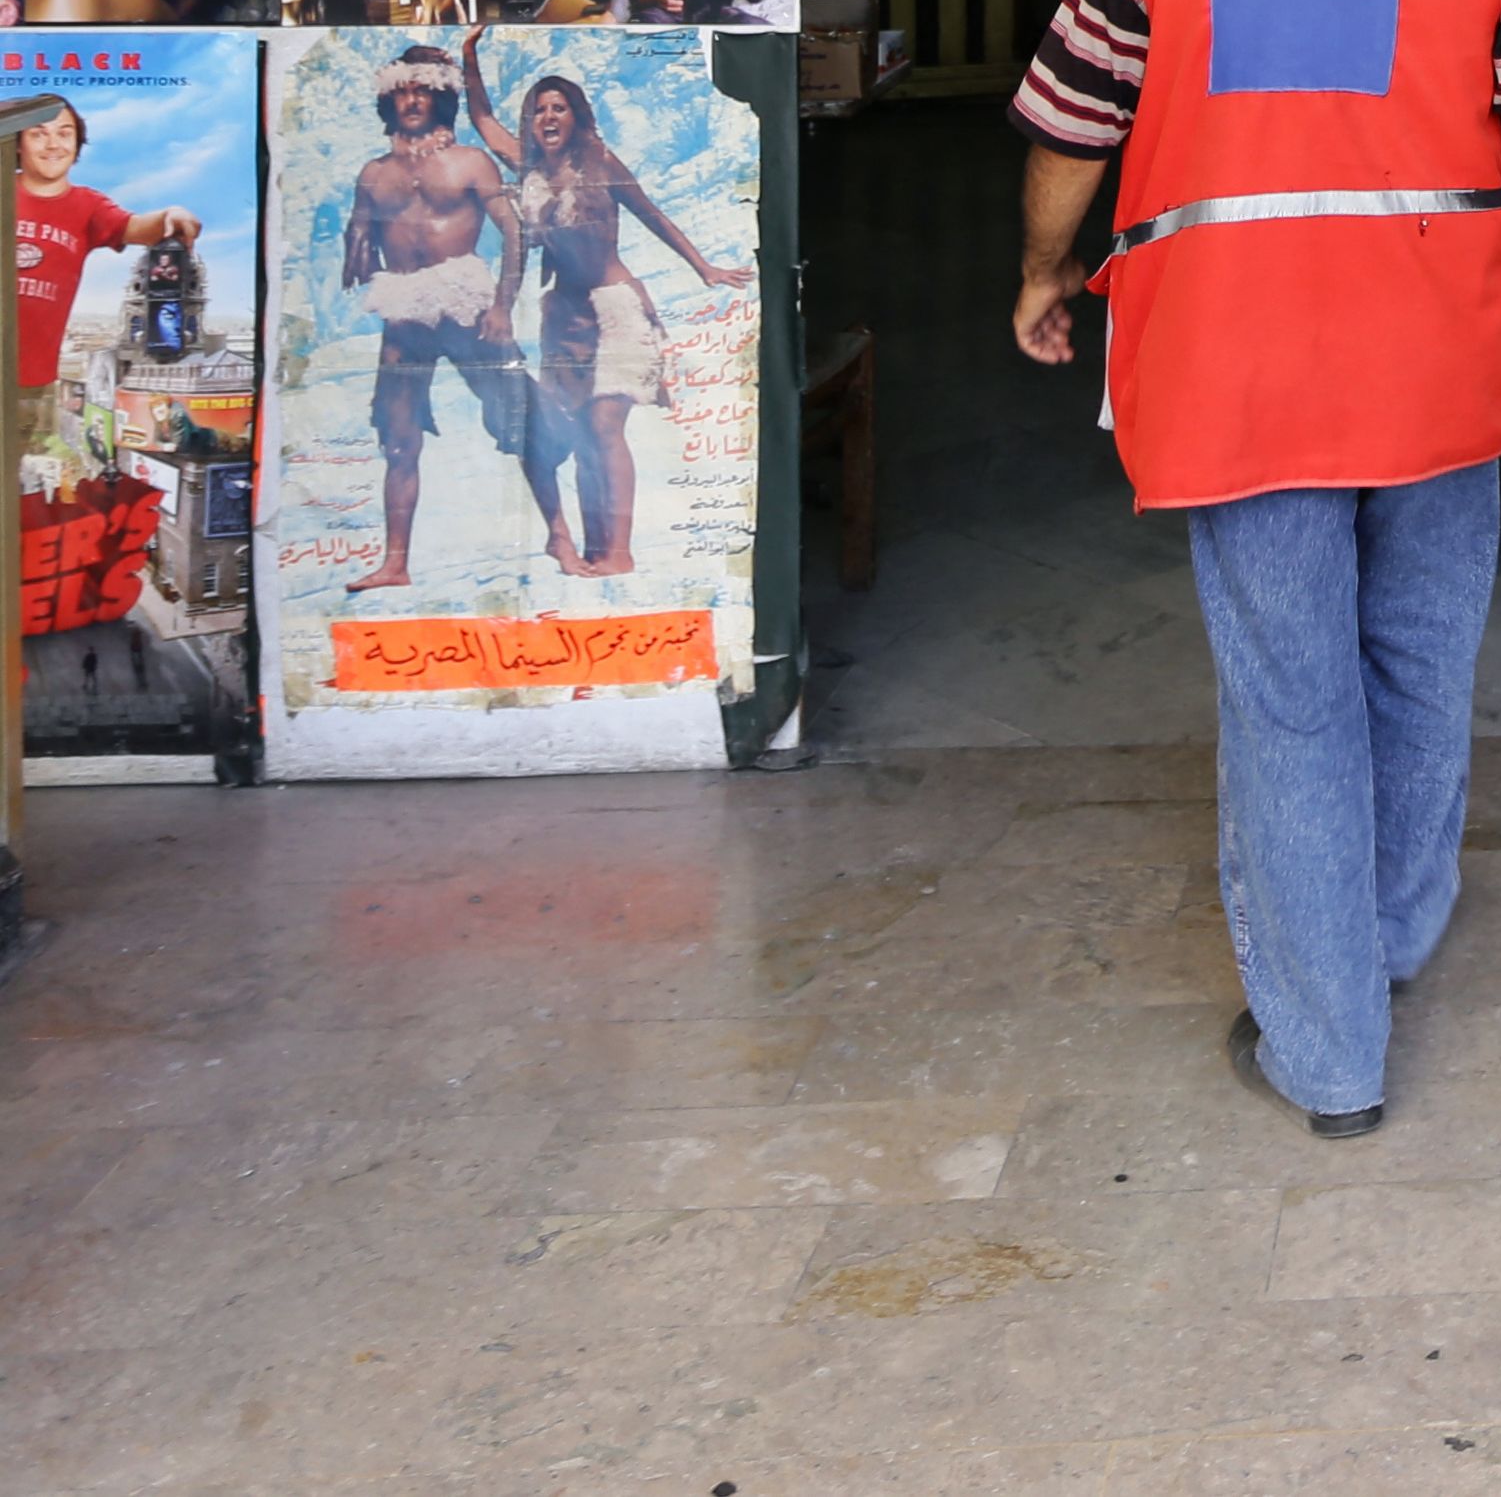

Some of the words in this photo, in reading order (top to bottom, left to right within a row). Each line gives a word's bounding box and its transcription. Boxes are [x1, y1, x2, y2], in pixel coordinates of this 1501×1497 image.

[4, 52, 142, 71] BLACK
[30, 77, 48, 86] OF
[54, 77, 84, 86] EPIC
[89, 77, 192, 87] PROPORTIONS.
[18, 277, 58, 301] TBALL
[22, 491, 166, 582] ER'S
[22, 553, 150, 638] ELS
[363, 630, 488, 677] المصرية
[489, 628, 582, 677] السينما
[582, 624, 630, 680] نجوم
[634, 633, 657, 656] من
